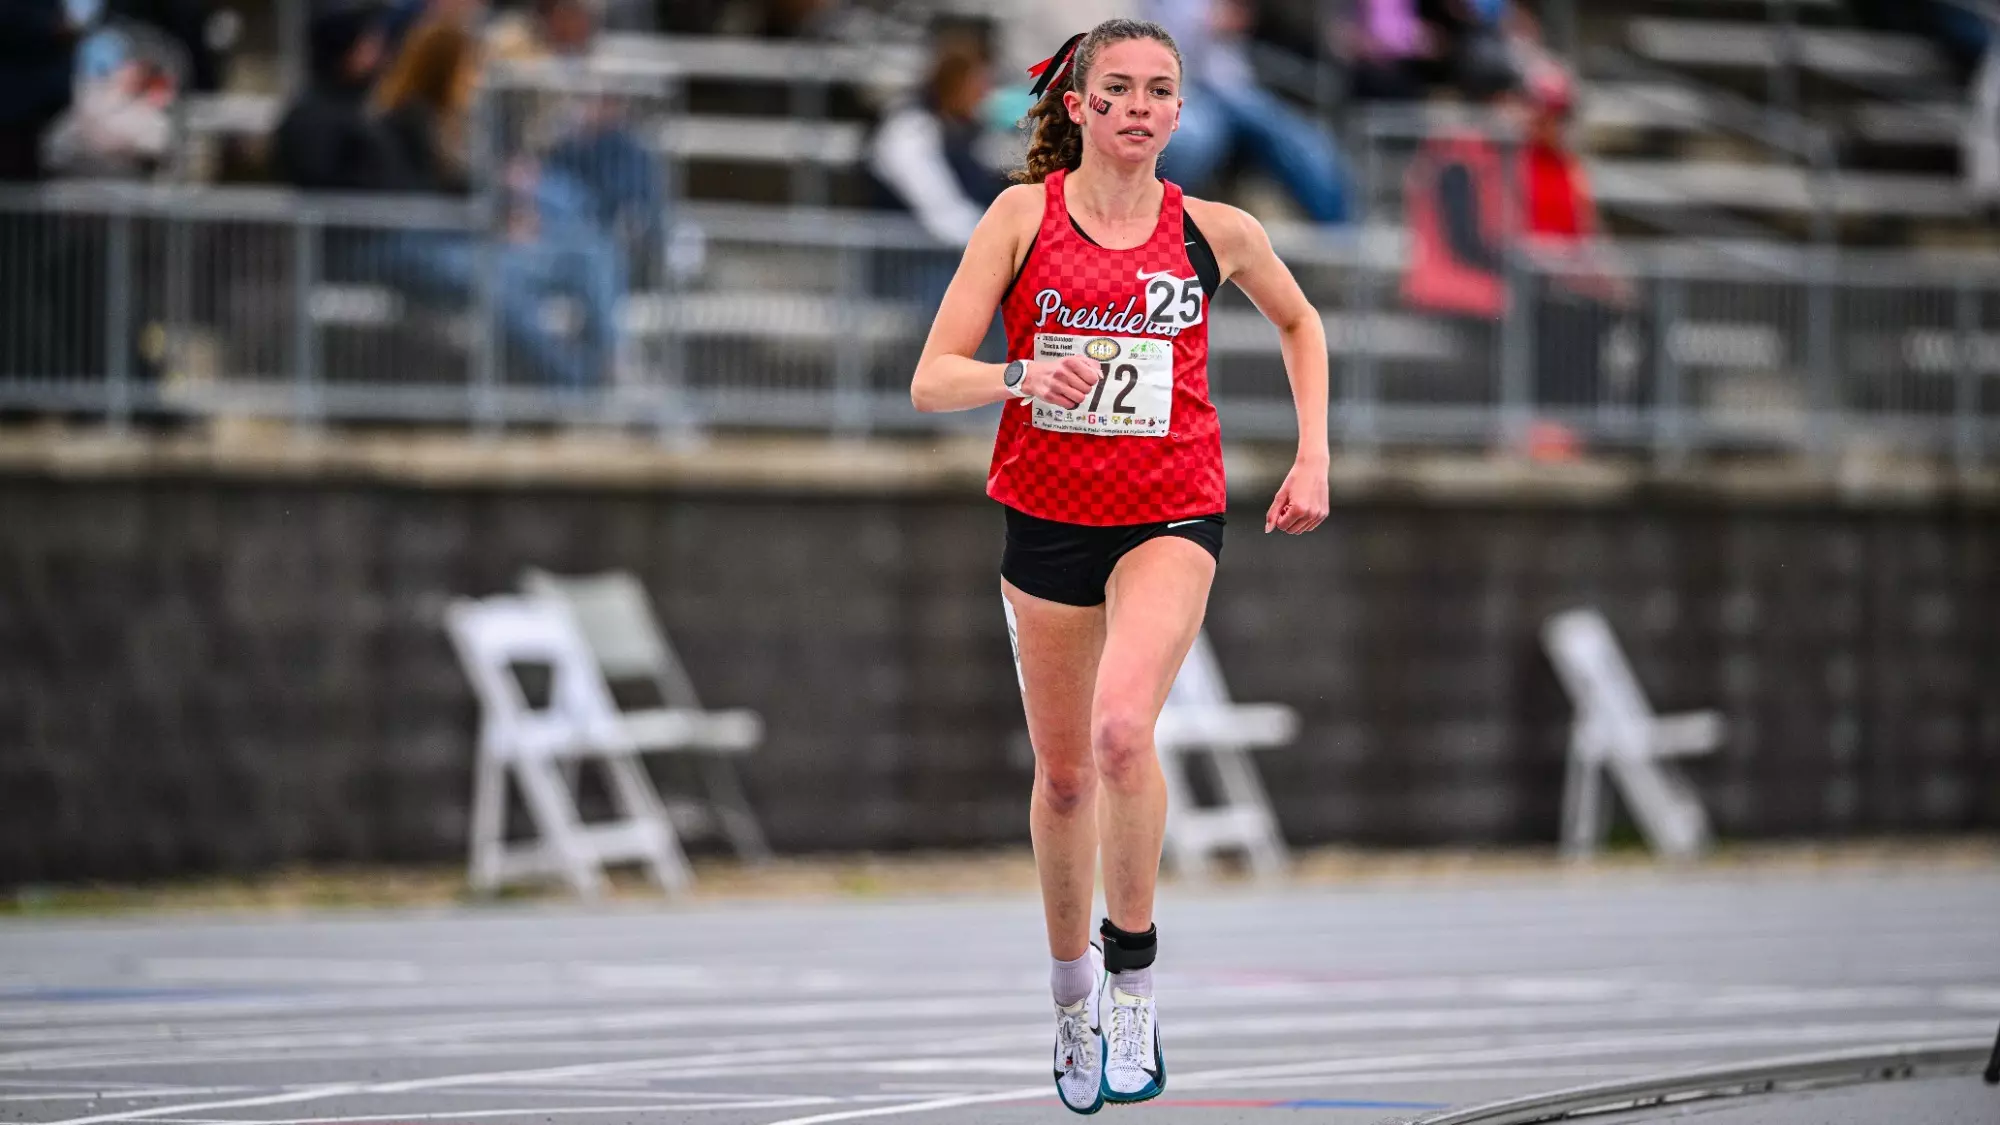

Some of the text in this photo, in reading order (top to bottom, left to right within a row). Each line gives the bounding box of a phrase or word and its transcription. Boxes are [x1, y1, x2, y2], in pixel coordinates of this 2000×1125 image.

[1149, 280, 1201, 323] 25
[1066, 363, 1139, 414] 72
[1088, 414, 1096, 424] G
